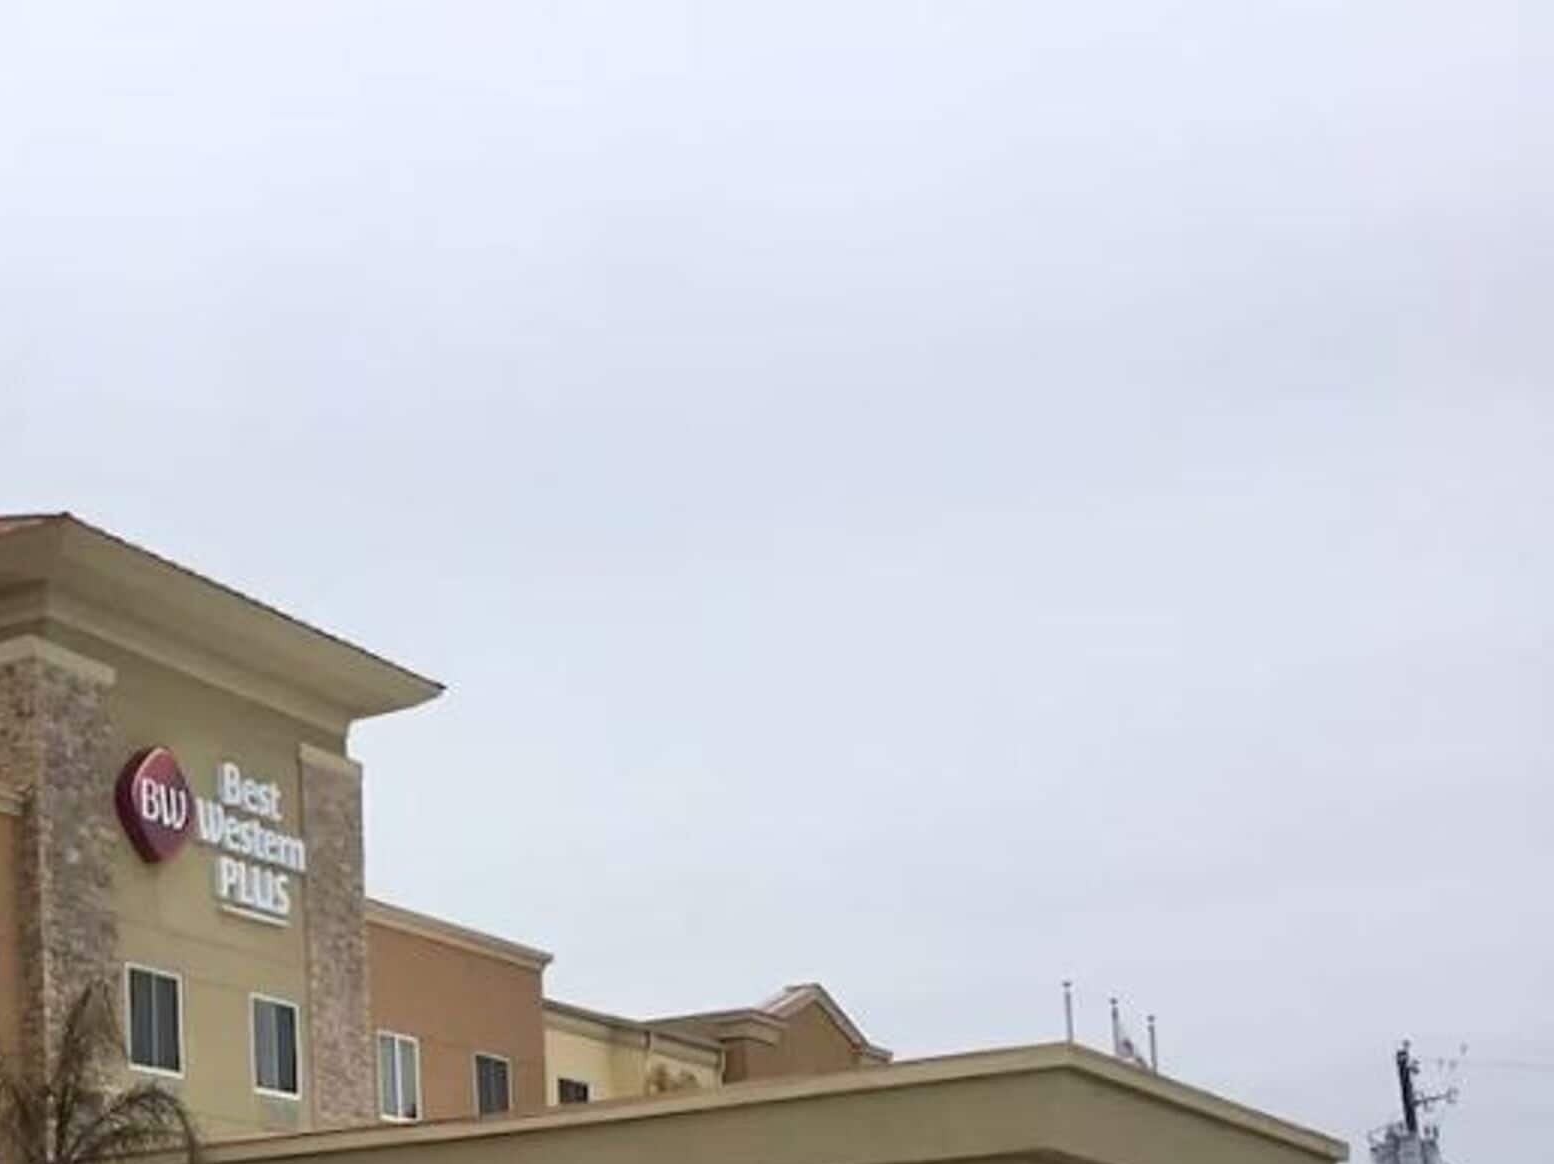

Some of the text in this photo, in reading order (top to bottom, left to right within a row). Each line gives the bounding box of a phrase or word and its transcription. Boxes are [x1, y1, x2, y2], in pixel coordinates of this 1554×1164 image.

[140, 777, 187, 830] BW
[221, 762, 282, 821] Best
[197, 797, 306, 872] Western
[219, 855, 290, 914] PLUS
